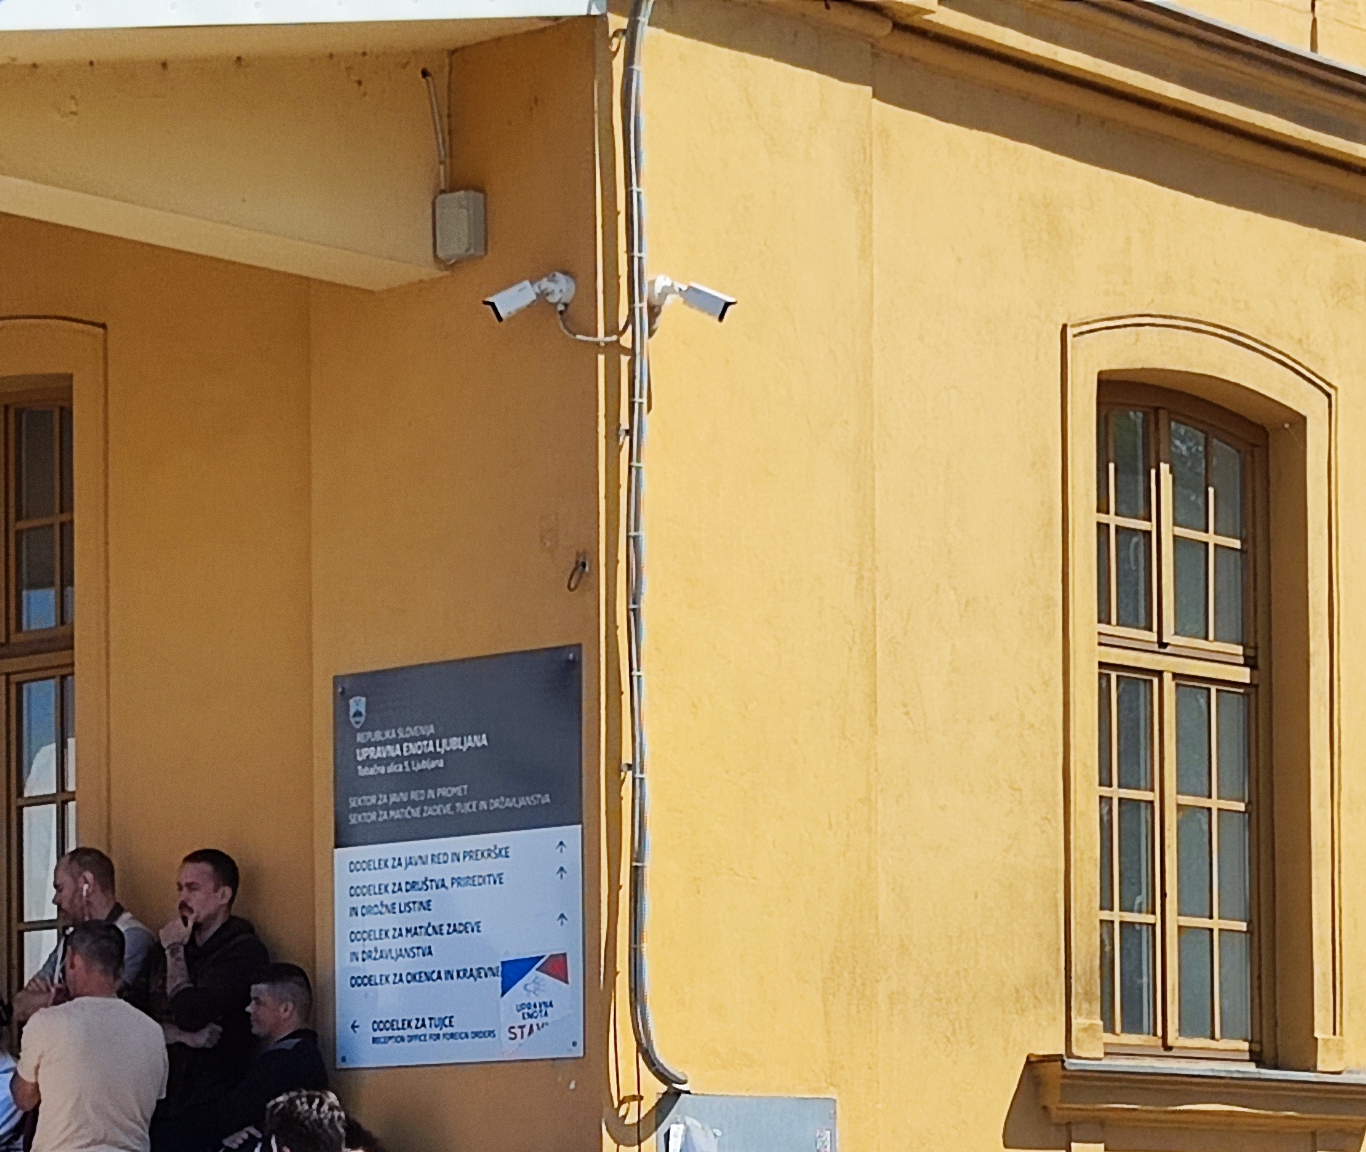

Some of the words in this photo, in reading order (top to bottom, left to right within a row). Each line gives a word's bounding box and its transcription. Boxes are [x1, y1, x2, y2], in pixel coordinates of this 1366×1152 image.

[356, 743, 402, 761] UPRAVNA
[402, 740, 434, 756] ENOTA
[435, 733, 488, 754] LJUBLJANA
[348, 857, 390, 873] ODDELEK
[390, 856, 403, 869] ZA
[404, 853, 429, 870] JAVNI
[430, 852, 450, 866] RED
[450, 851, 461, 863] IN
[462, 844, 511, 863] PREKRŠKE
[348, 882, 390, 898] ODDELEK
[391, 881, 403, 894] ZA
[450, 872, 505, 889] PRIREDITVE
[348, 906, 359, 918] IN
[360, 900, 397, 917] OROŽNE
[398, 899, 433, 914] LISTINE
[349, 928, 391, 943] ODDELEK
[391, 927, 404, 940] ZA
[405, 922, 445, 938] MATIČNE
[446, 920, 482, 935] ZADEVE
[349, 951, 359, 963] IN
[361, 945, 434, 963] DRŽAVLJANSTVA
[349, 973, 391, 988] ODDELEK
[392, 972, 404, 985] ZA
[405, 969, 443, 984] OKENCA
[444, 969, 454, 981] IN
[456, 965, 501, 982] KRAJEVNE
[371, 1018, 413, 1032] ODDELEK
[414, 1017, 427, 1029] ZA
[428, 1015, 455, 1031] TUJCE
